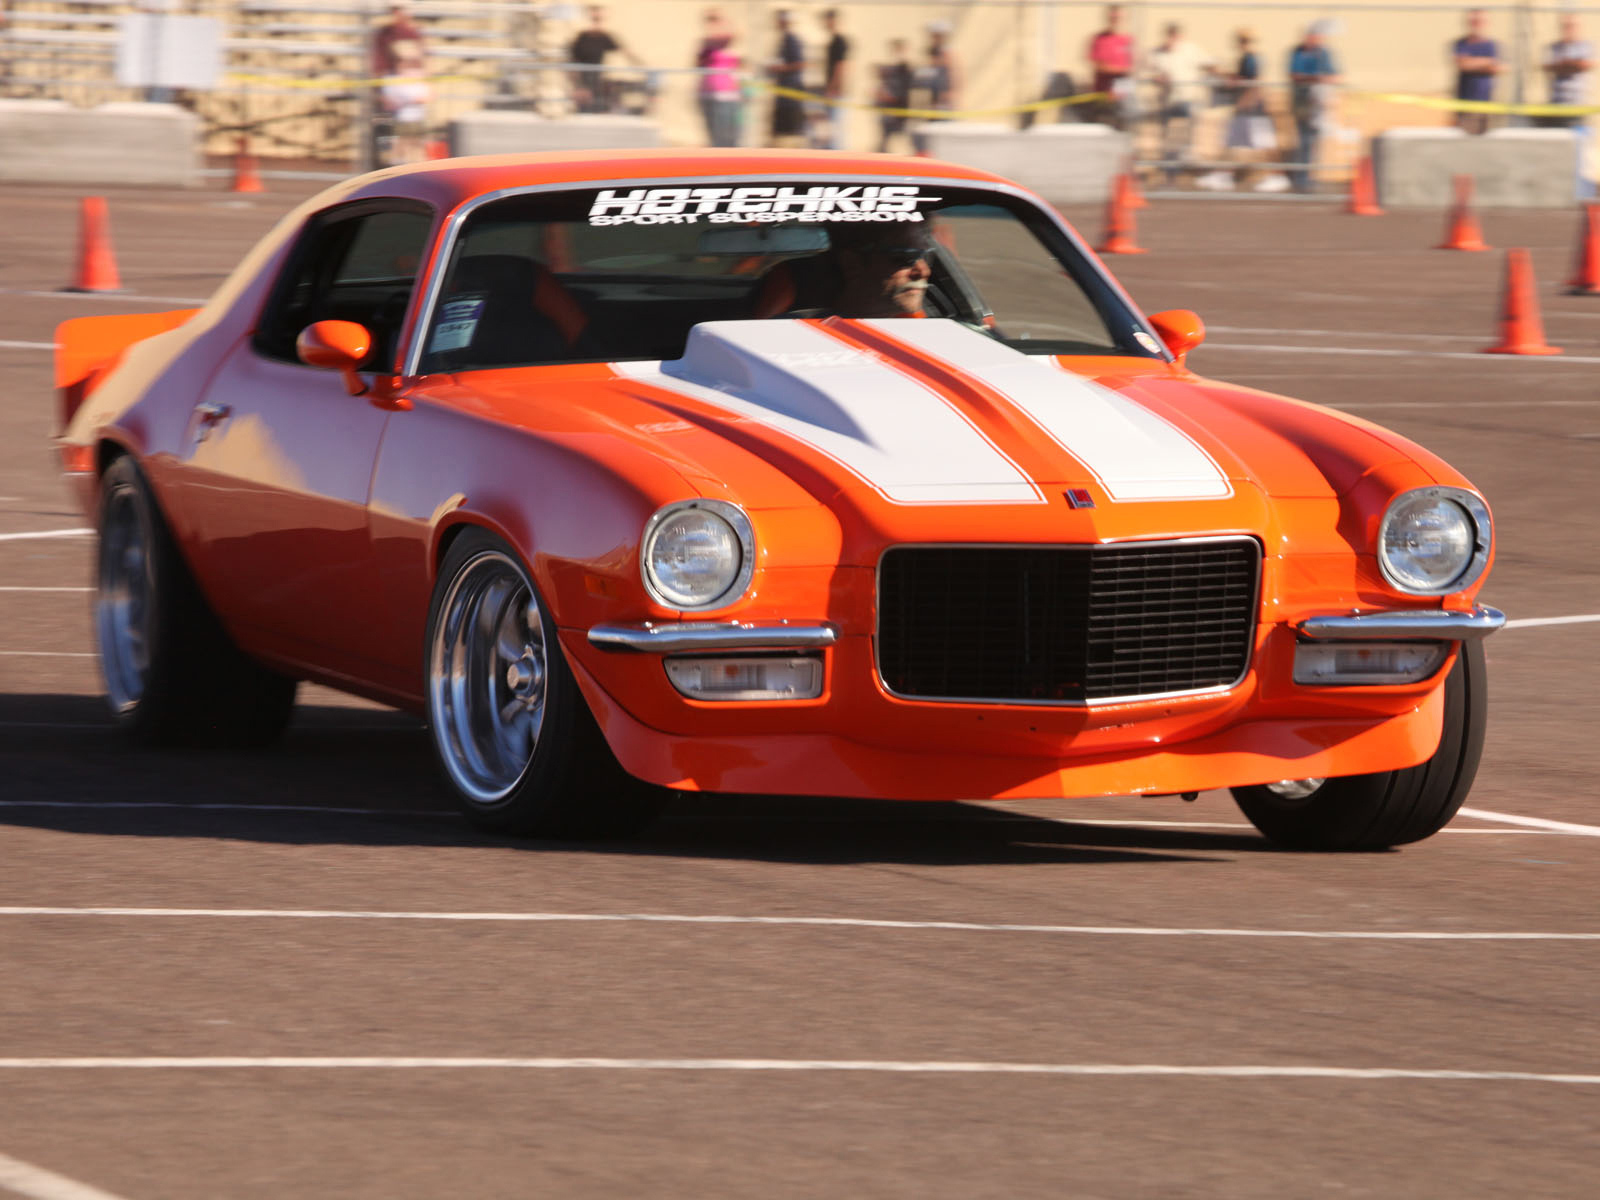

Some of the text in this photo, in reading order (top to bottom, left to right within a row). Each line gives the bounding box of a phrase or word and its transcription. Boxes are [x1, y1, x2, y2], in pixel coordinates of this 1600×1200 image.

[588, 186, 920, 216] HOTCHKIS
[588, 211, 925, 227] SPORT SUSPENSION
